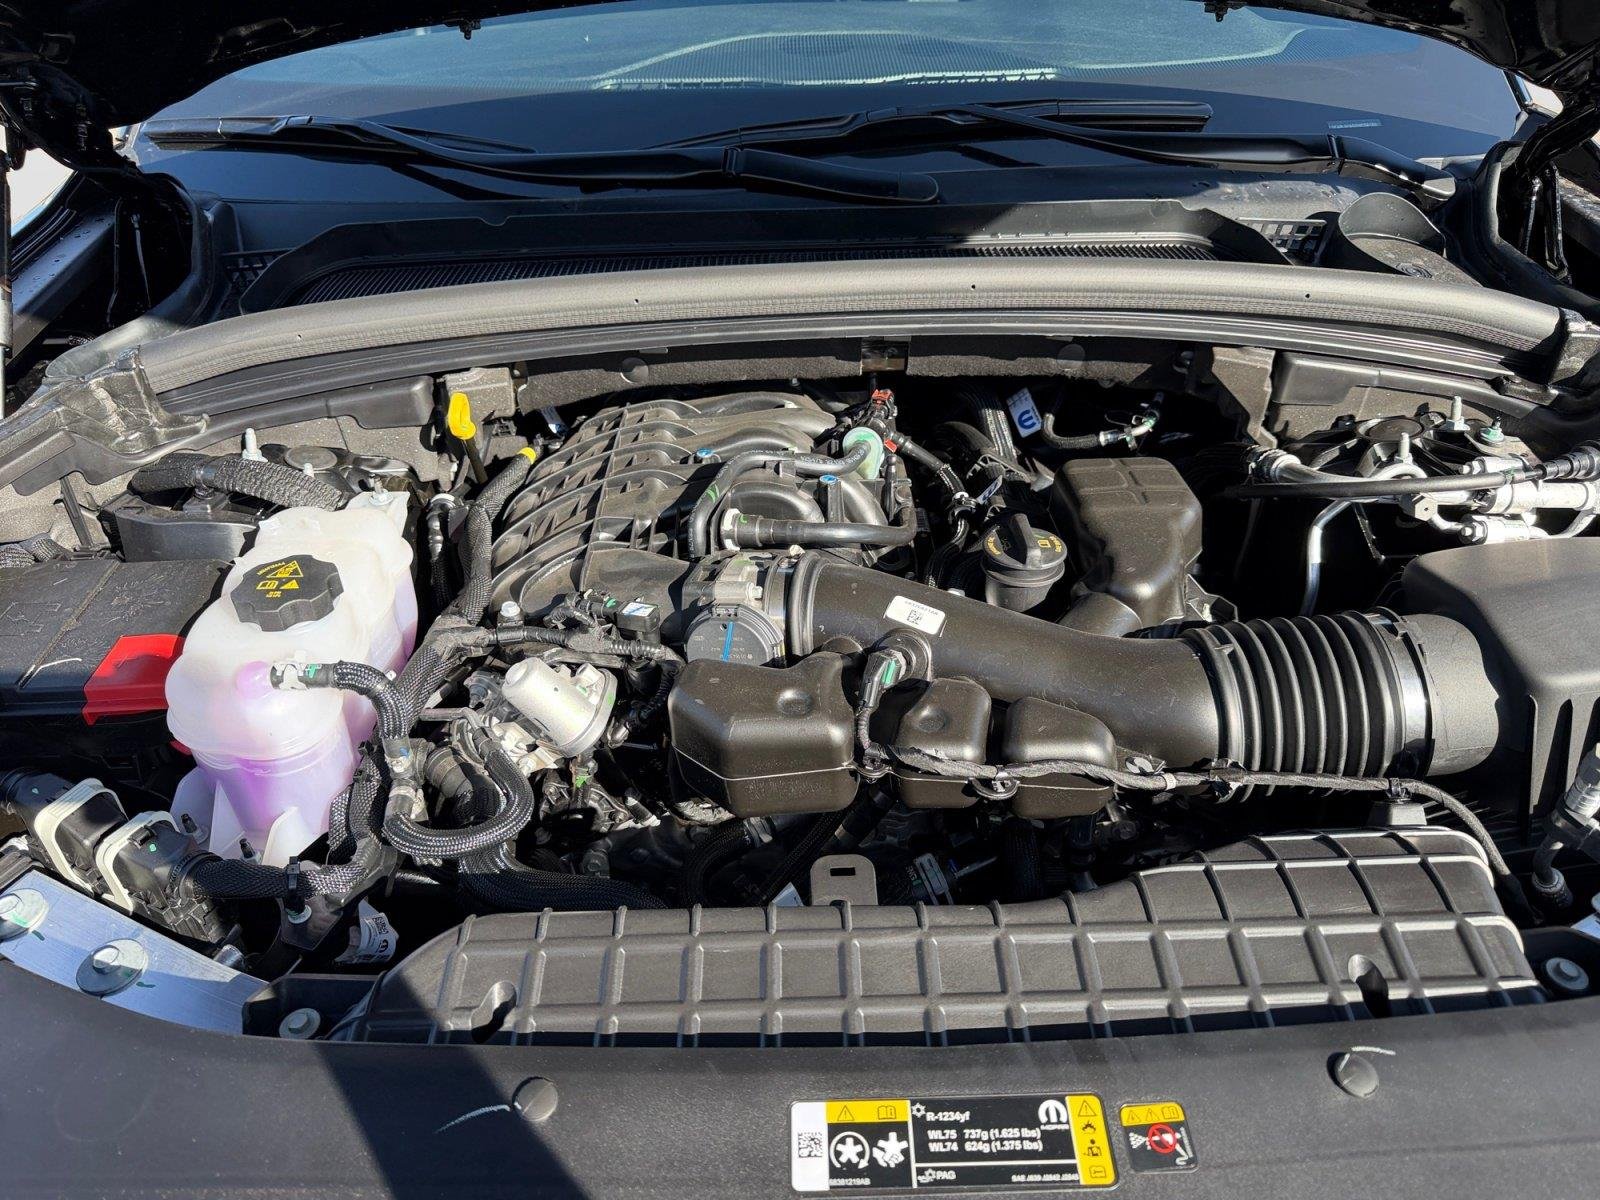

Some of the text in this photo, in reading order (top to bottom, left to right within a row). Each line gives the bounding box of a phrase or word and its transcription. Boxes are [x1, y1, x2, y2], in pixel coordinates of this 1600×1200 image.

[925, 1110, 970, 1123] R-1234yf
[927, 1126, 1042, 1141] WL75 737g (1.625 lbs)
[928, 1139, 1043, 1153] WL74 624g (1.375 lbs)
[936, 1169, 957, 1180] PAG
